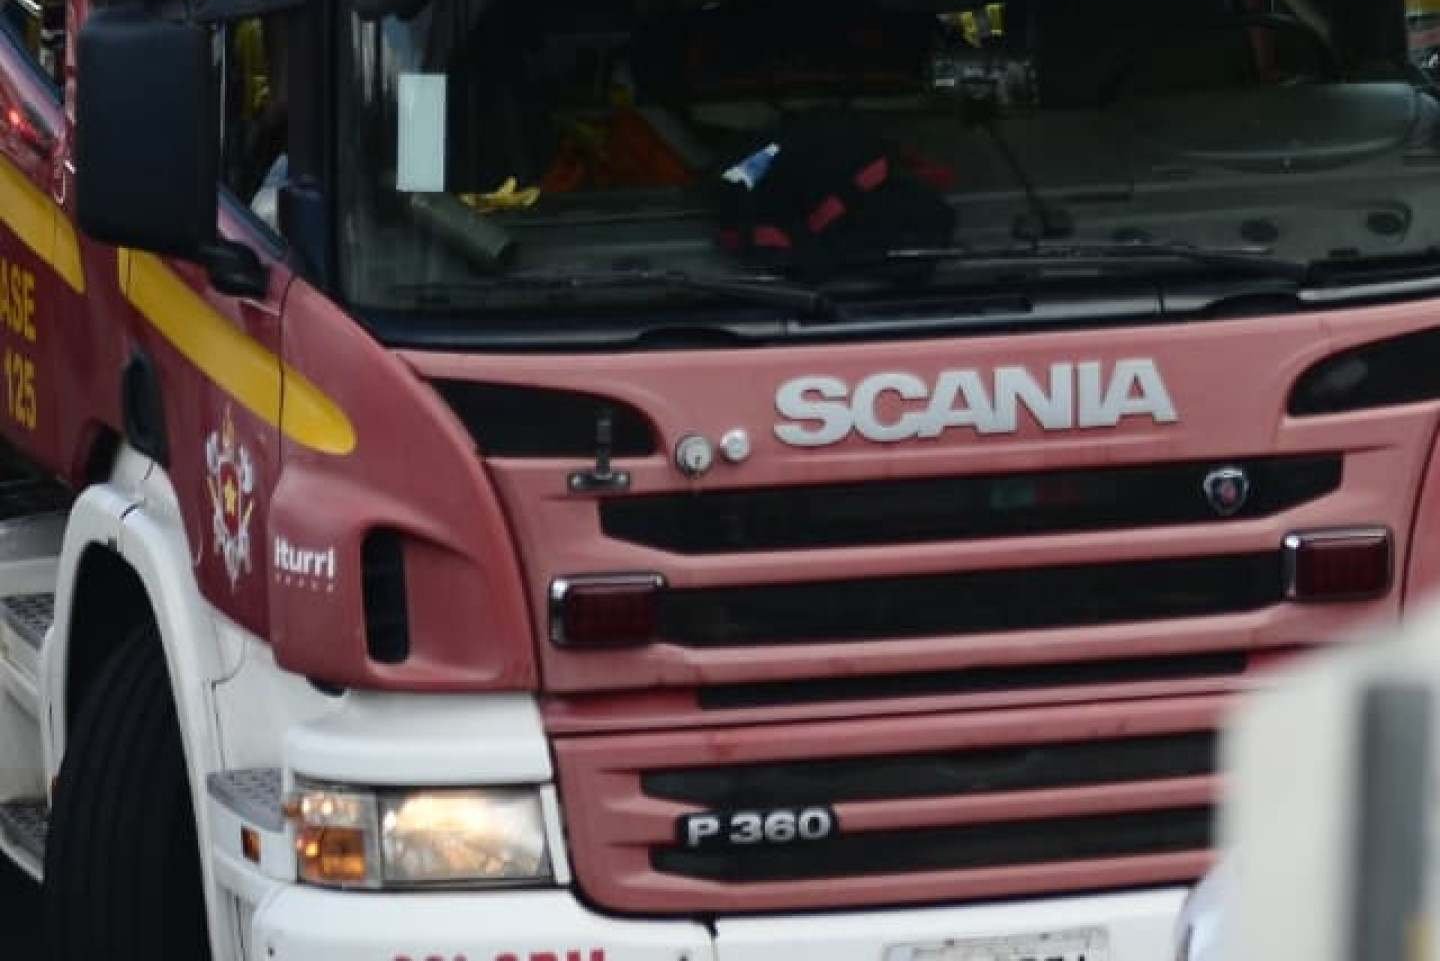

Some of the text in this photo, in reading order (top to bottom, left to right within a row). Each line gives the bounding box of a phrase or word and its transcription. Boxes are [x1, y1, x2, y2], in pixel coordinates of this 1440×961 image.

[773, 357, 1178, 446] SCANIA
[687, 807, 831, 848] P 360
